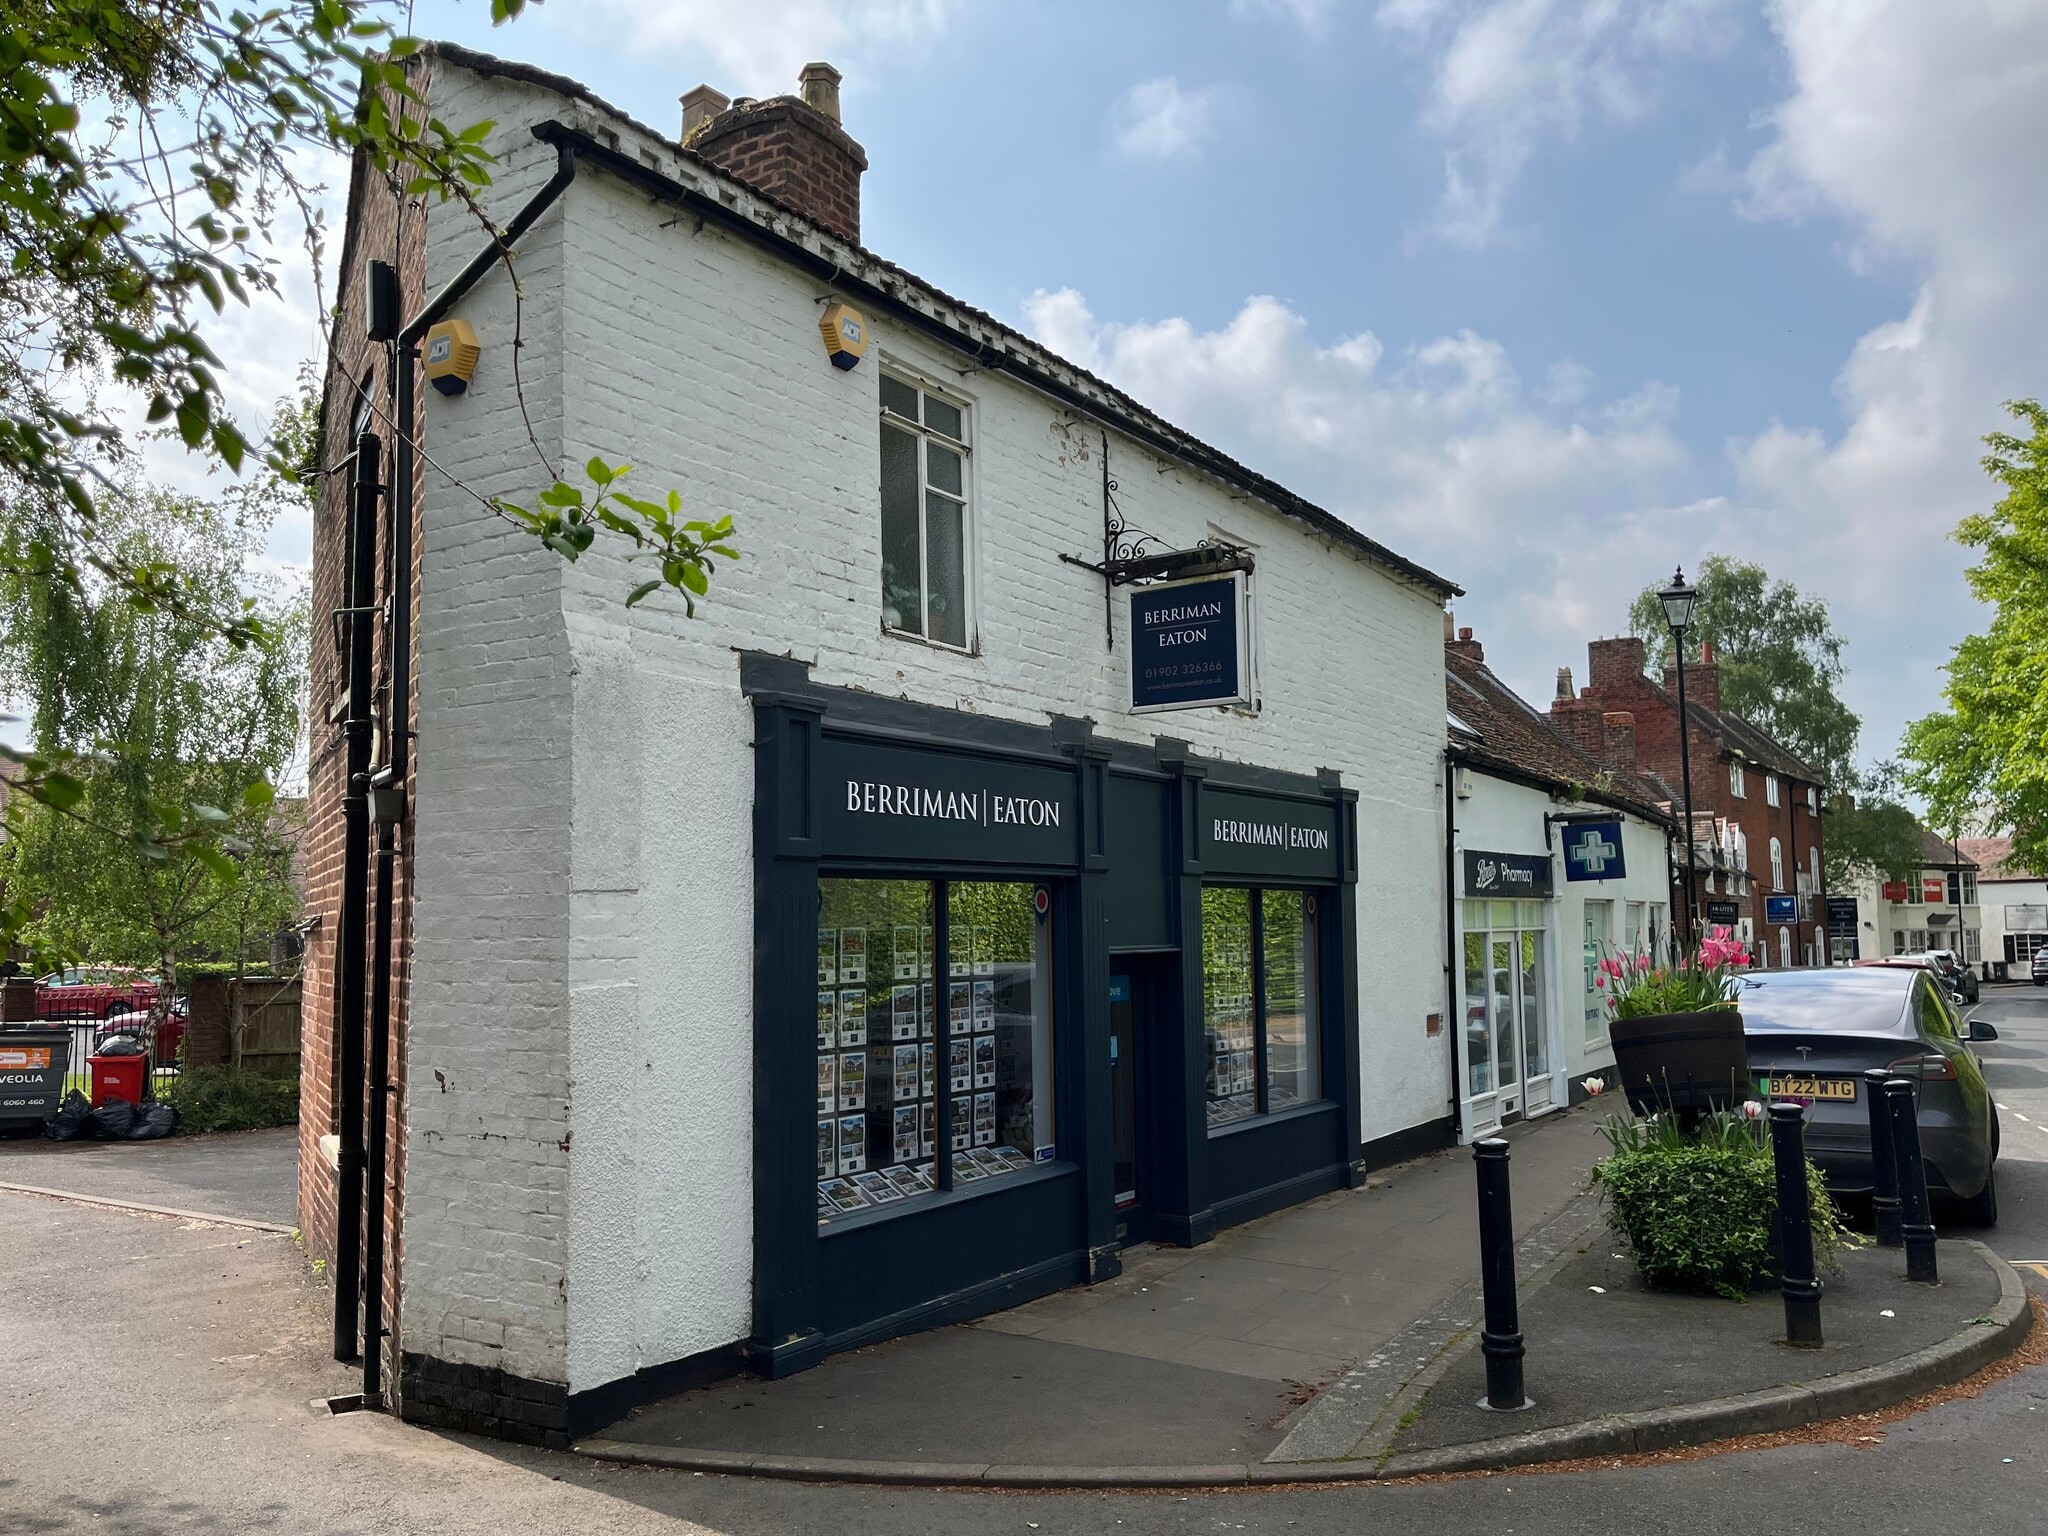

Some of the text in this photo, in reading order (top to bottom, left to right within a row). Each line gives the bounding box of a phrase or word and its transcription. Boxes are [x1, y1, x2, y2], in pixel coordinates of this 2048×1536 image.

[843, 322, 861, 340] ADT
[429, 340, 450, 360] ADT
[1144, 601, 1222, 625] BERRIMAN
[1159, 628, 1207, 647] EATON
[1145, 661, 1222, 679] 01902 326366
[846, 780, 1060, 827] BERRIMAN EATON
[1213, 818, 1328, 850] BERRIMAN EATON
[1501, 862, 1533, 888] Pharmacy
[0, 1074, 44, 1084] VEOLIA
[1771, 1080, 1852, 1096] BT22 WTG
